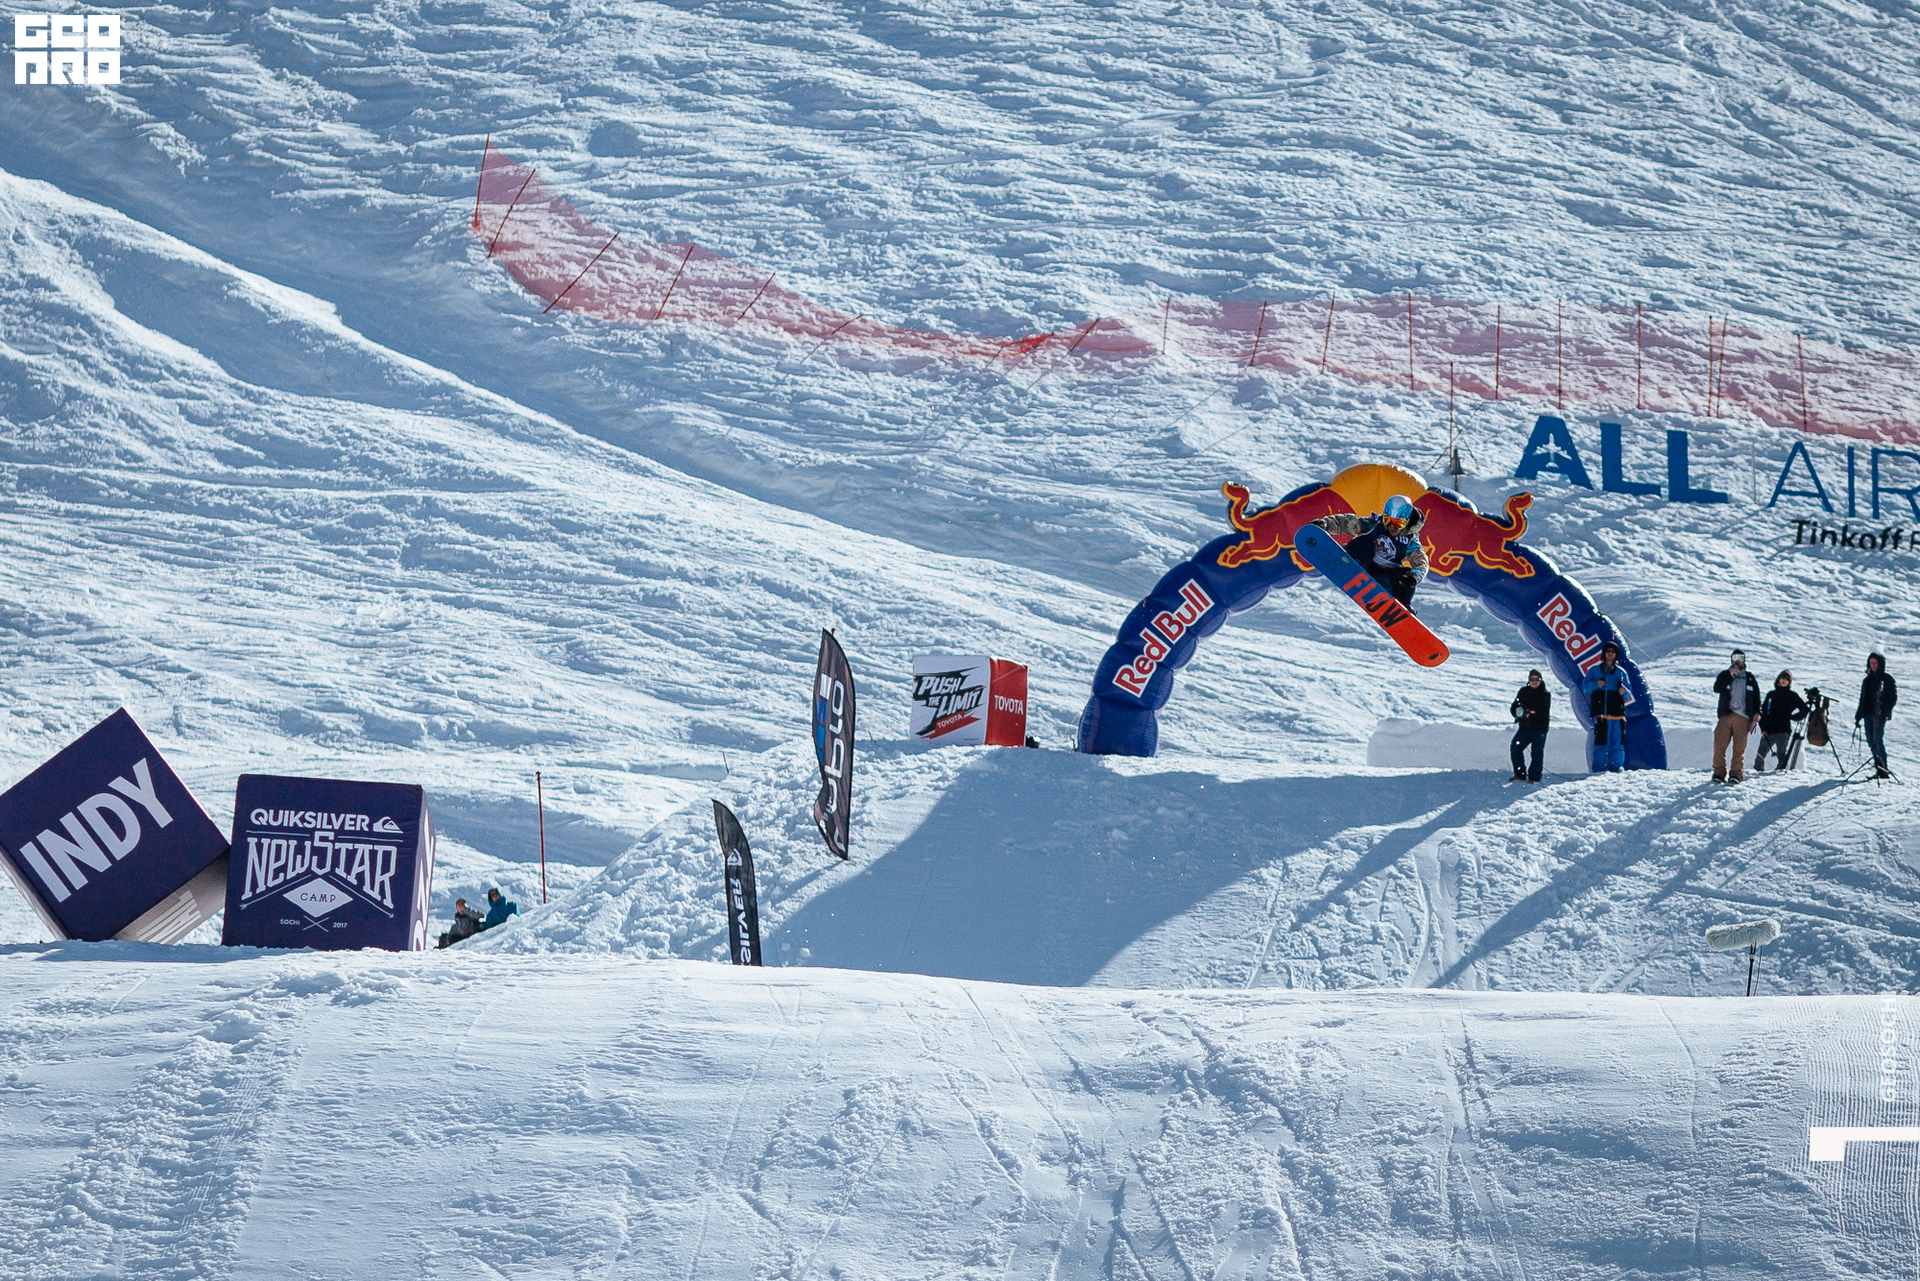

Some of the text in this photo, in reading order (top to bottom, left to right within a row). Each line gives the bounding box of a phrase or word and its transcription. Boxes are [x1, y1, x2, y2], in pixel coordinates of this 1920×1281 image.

[1513, 416, 1729, 503] ALL
[1791, 519, 1904, 551] Tinkoff
[1342, 572, 1409, 628] FLOW
[1112, 578, 1215, 698] Red Bull
[1536, 591, 1602, 660] Red
[918, 676, 962, 695] PUSH
[936, 690, 981, 718] LIMIT
[994, 694, 1024, 715] TOYOTA
[937, 713, 963, 728] TOYOTA
[19, 757, 174, 903] INDY
[250, 808, 370, 831] QUIKSILVER
[300, 893, 336, 903] CAMP
